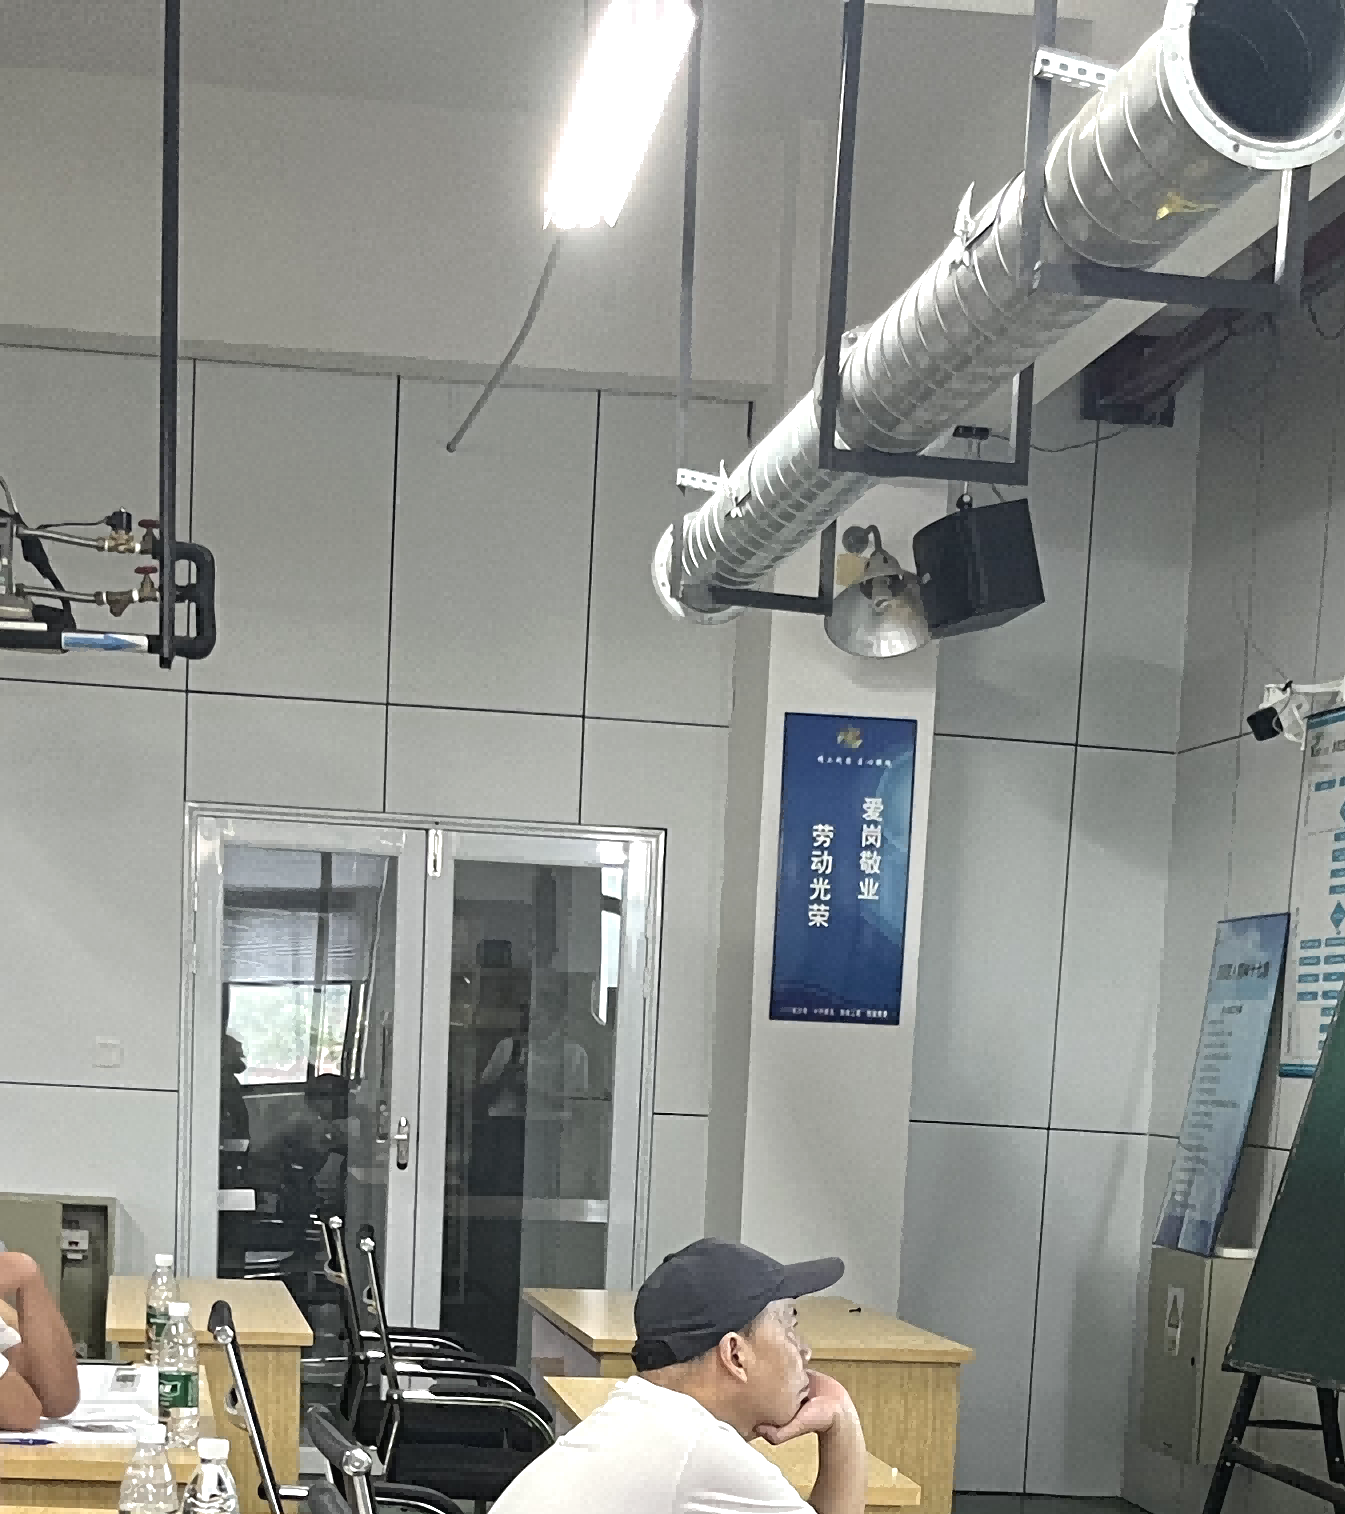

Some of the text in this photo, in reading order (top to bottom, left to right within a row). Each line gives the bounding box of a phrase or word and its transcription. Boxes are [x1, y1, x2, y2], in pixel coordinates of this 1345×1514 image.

[808, 824, 835, 928] 劳动光荣
[857, 797, 884, 901] 爱岗敬业
